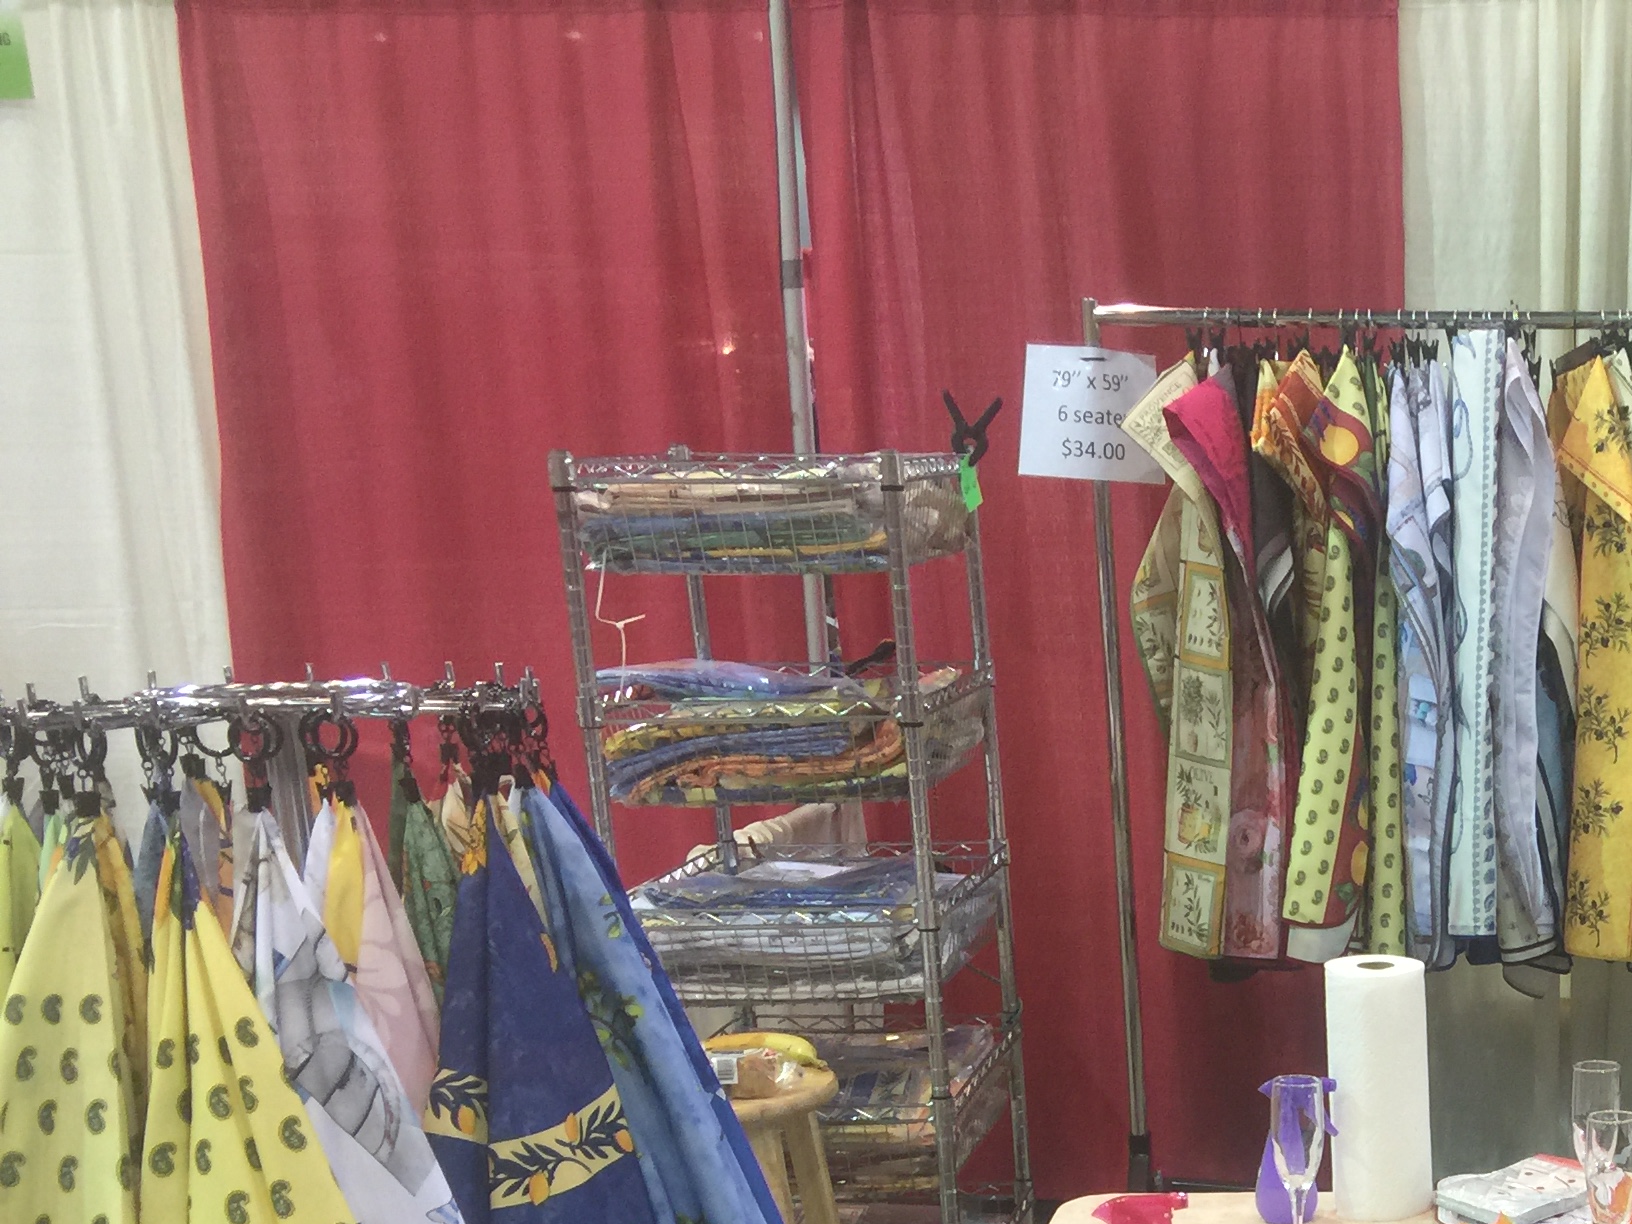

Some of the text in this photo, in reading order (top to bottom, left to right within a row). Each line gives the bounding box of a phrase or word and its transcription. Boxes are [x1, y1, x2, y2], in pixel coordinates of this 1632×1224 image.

[1086, 375, 1097, 390] x
[1102, 374, 1129, 392] 59"
[1057, 404, 1127, 425] 6 seate
[1061, 437, 1126, 461] $34.00
